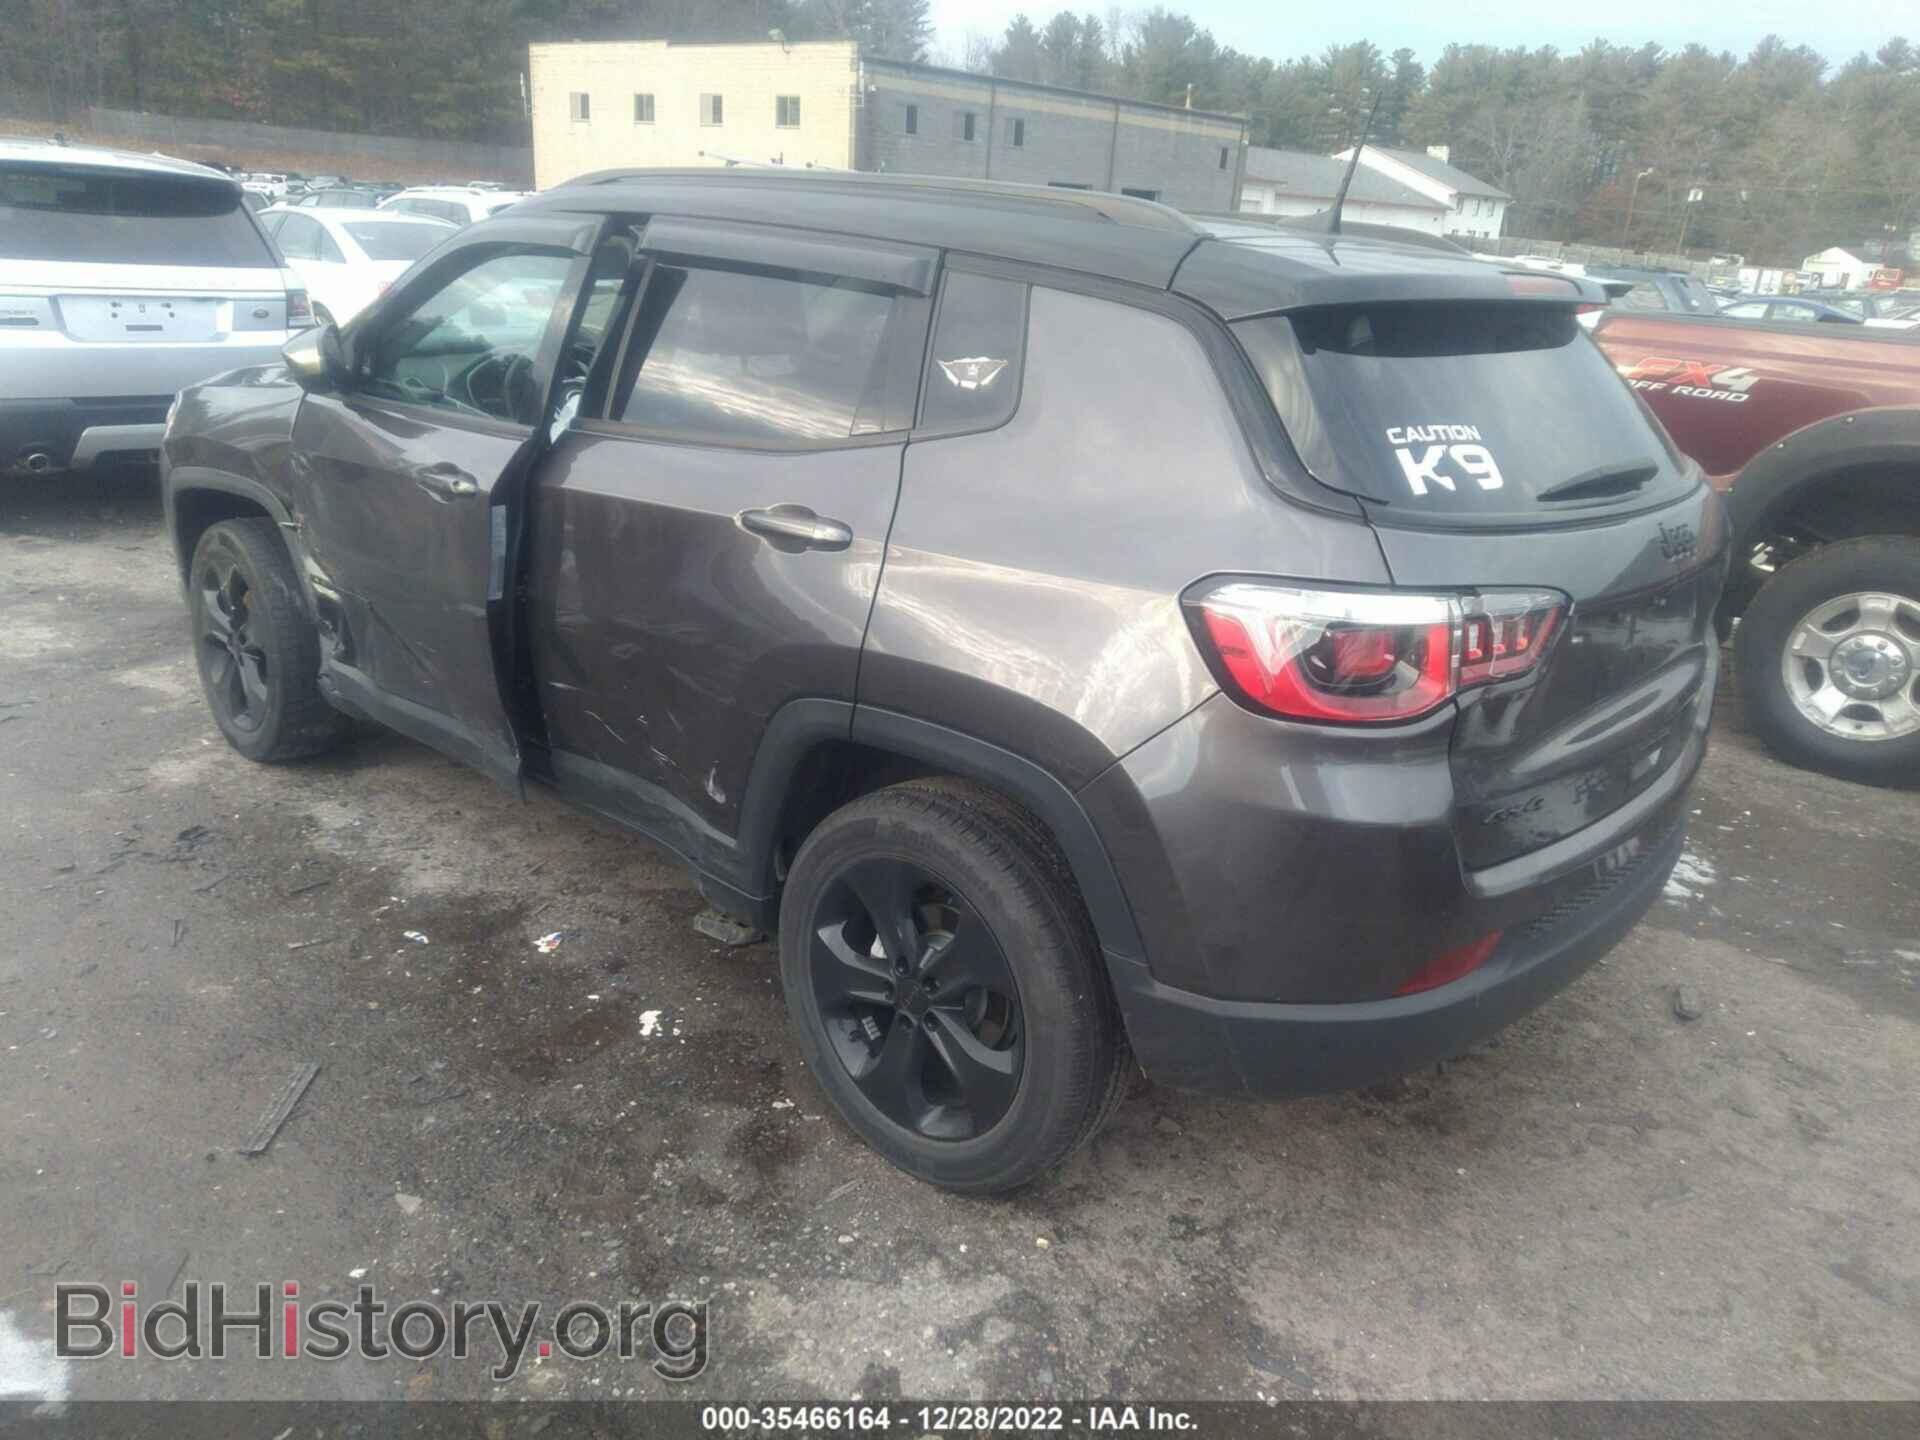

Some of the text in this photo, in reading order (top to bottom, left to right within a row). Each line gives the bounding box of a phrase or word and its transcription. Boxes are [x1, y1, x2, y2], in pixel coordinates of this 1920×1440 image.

[1617, 357, 1760, 391] FX4
[1671, 385, 1749, 402] ROAD
[1386, 424, 1481, 444] CAUTION
[1394, 444, 1504, 495] K9
